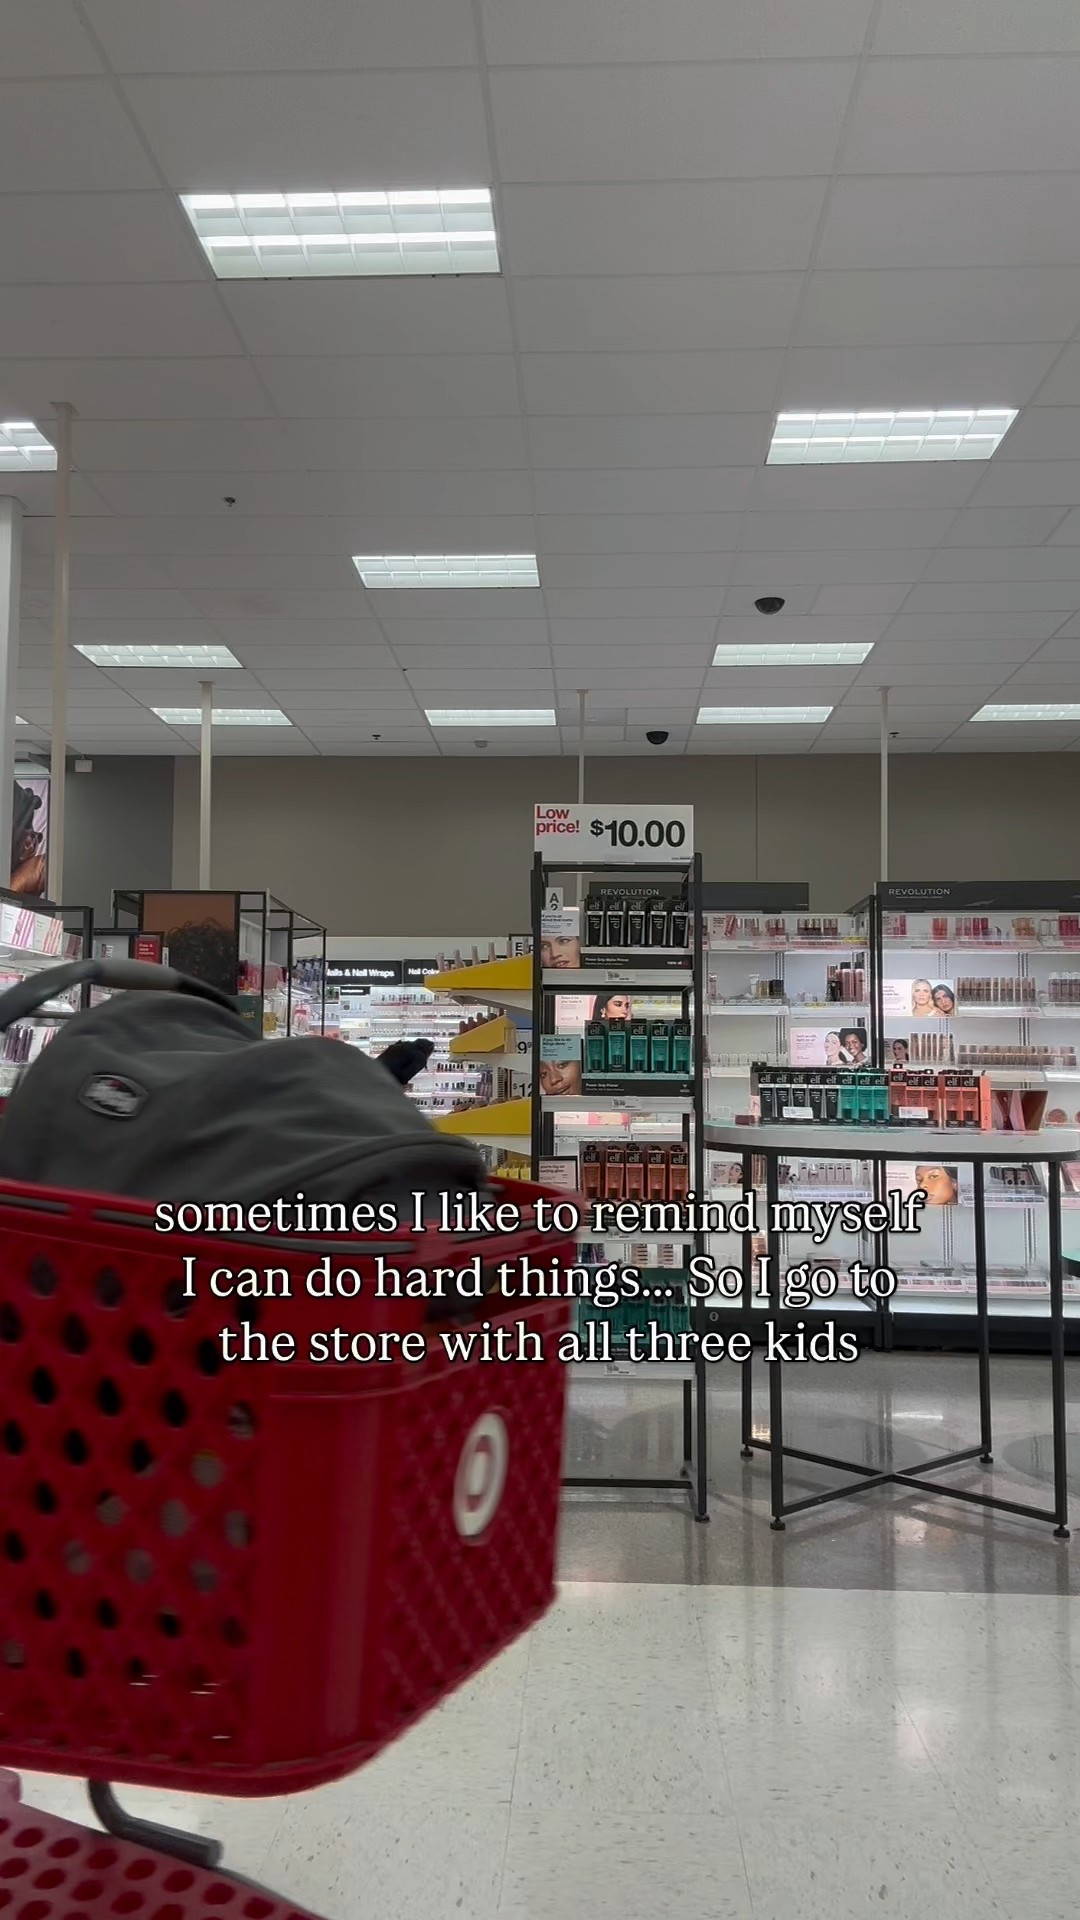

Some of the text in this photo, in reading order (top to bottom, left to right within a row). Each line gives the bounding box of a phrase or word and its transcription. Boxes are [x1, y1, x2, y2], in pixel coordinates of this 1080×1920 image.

[536, 805, 570, 819] Low
[536, 820, 580, 836] price!
[590, 818, 686, 848] $10.00
[600, 888, 659, 896] REVOLUTION
[888, 888, 951, 896] REVOLUTION
[549, 892, 559, 903] A
[352, 968, 368, 977] Nail
[368, 968, 395, 979] Wraps
[408, 967, 421, 975] Nail
[589, 1024, 601, 1034] elf
[611, 1020, 622, 1031] elf
[632, 1025, 645, 1035] elf
[654, 1025, 666, 1036] elf
[677, 1024, 689, 1035] elf
[760, 1074, 771, 1084] elf
[776, 1074, 787, 1084] elf
[793, 1074, 804, 1084] elf
[810, 1075, 821, 1084] elf
[826, 1075, 837, 1084] elf
[842, 1075, 853, 1085] elf
[860, 1076, 871, 1085] elf
[875, 1075, 886, 1085] elf
[908, 1077, 919, 1086] elf
[924, 1077, 935, 1086] elf
[947, 1077, 958, 1086] elf
[963, 1077, 975, 1086] elf
[585, 1152, 598, 1162] elf
[609, 1152, 621, 1163] elf
[629, 1152, 640, 1163] elf
[650, 1153, 662, 1163] elf
[673, 1154, 684, 1164] elf
